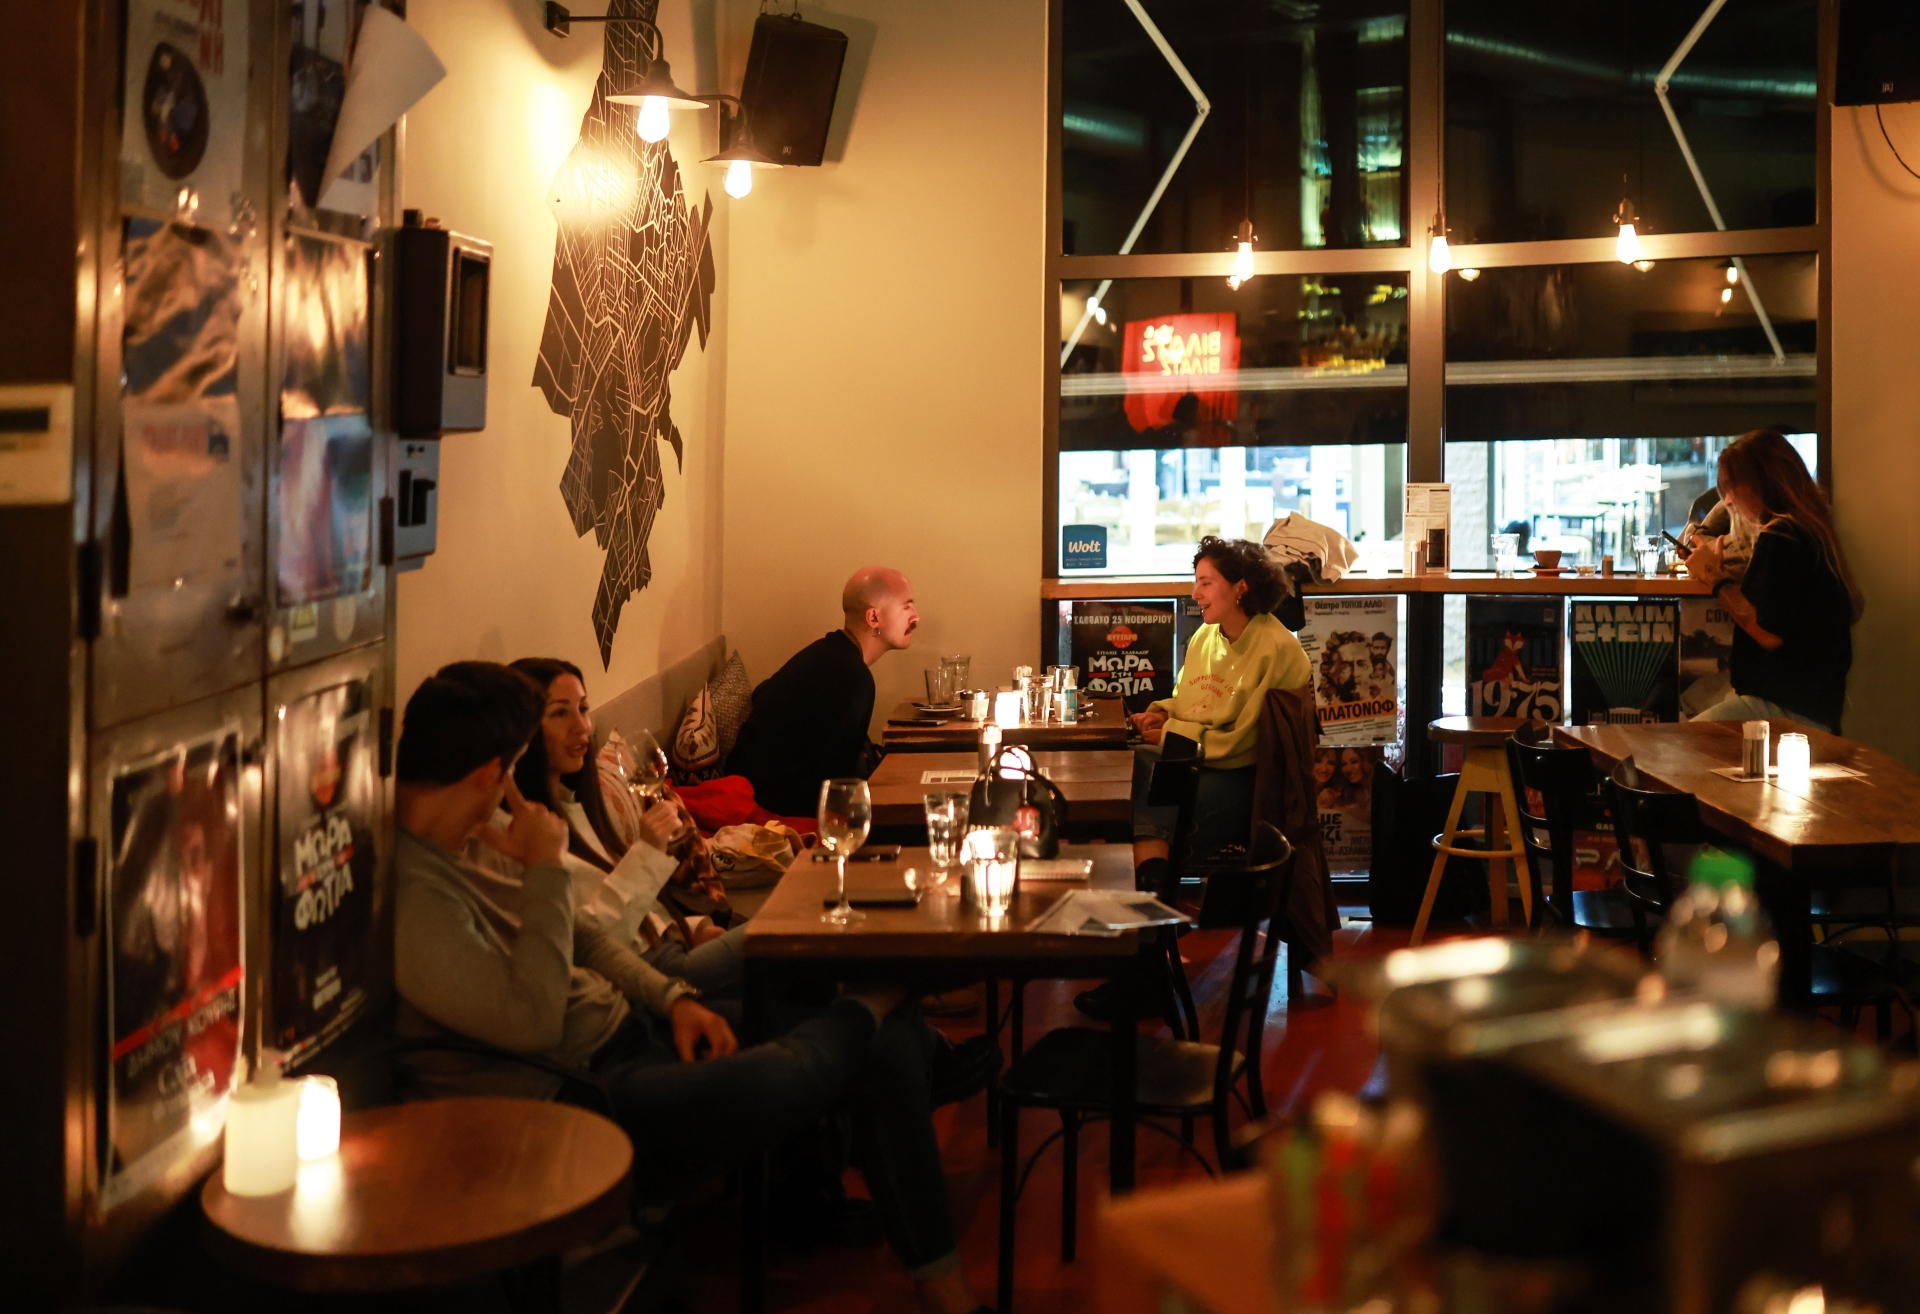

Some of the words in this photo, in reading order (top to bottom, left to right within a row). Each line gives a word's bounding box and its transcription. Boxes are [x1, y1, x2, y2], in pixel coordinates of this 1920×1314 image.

[1068, 540, 1101, 553] Wolt
[1315, 601, 1340, 610] Θέατρο
[1575, 605, 1675, 621] RAMM
[1074, 615, 1110, 625] ΣΑΒΒΑΤΟ
[1112, 615, 1122, 624] 25
[1125, 615, 1172, 624] ΝΟΕΜΒΡΙΟΥ
[1706, 609, 1734, 623] COV
[1575, 623, 1675, 642] STEIN
[1088, 655, 1154, 672] ΜΩΡΑ
[1088, 677, 1154, 696] ΦΩΤΙΑ
[1470, 680, 1560, 721] 1975
[1318, 700, 1395, 721] ΠΛΑΤΟΝΩΦ
[294, 815, 353, 876] ΜΩΡΑ
[294, 862, 353, 931] ΦΩΤΙΑ
